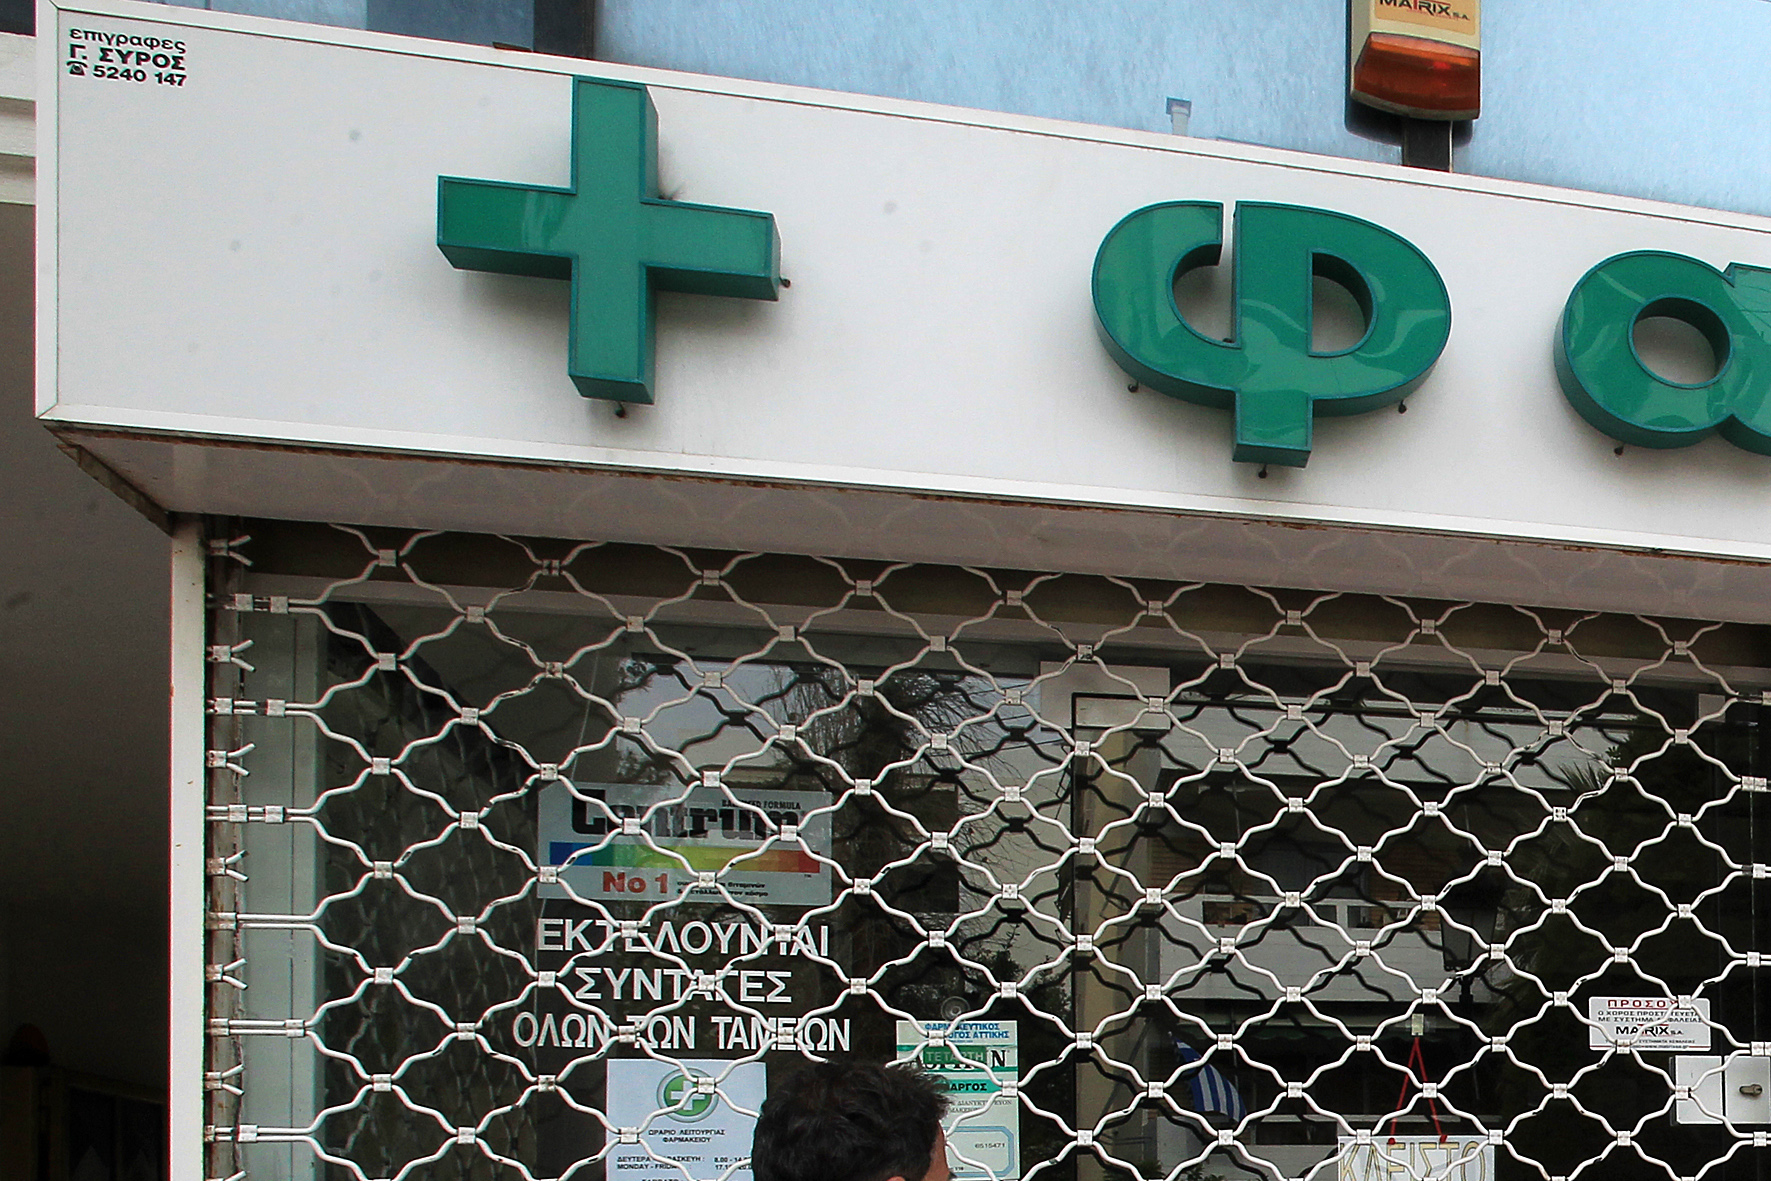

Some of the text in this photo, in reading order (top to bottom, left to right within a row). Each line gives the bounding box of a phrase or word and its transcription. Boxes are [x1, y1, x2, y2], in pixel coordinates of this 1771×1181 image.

[69, 28, 187, 54] επιγραφες
[69, 43, 186, 71] Γ. ΣΥΡΟΣ
[92, 65, 187, 87] 5240 147
[602, 871, 669, 894] No 1
